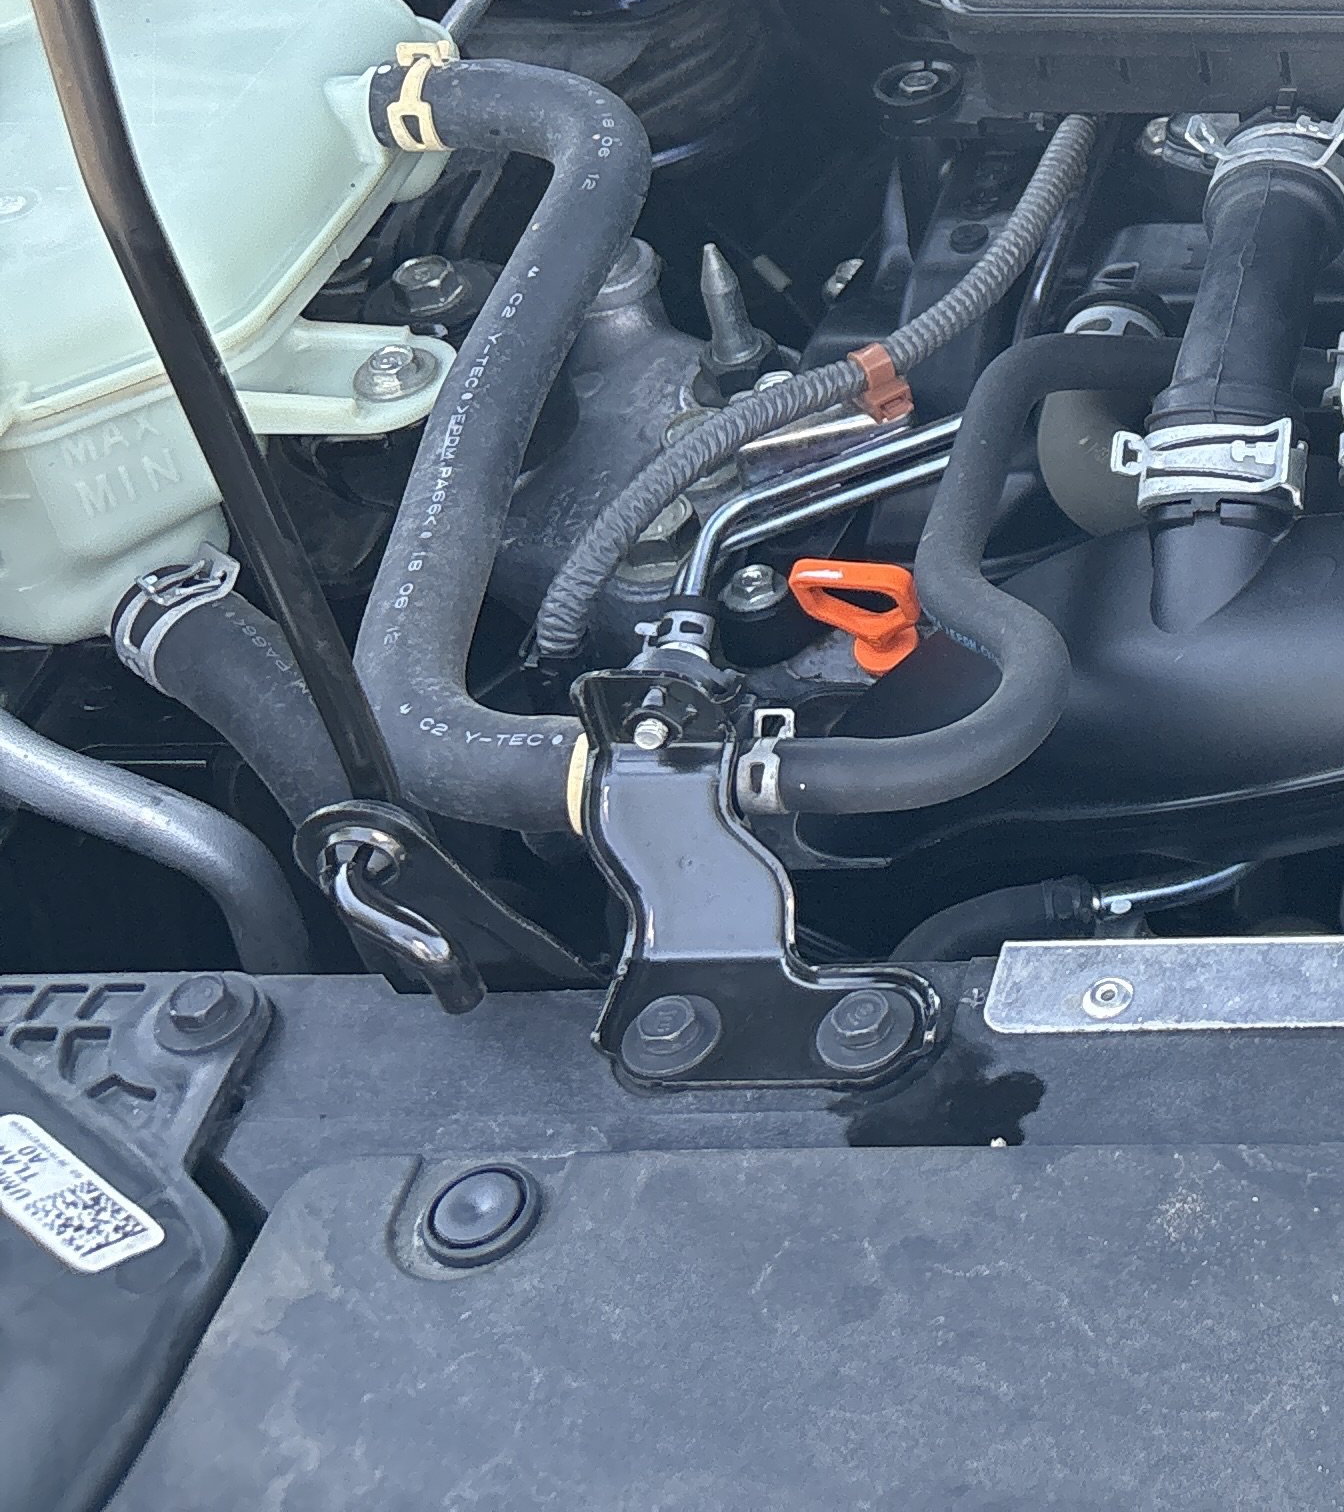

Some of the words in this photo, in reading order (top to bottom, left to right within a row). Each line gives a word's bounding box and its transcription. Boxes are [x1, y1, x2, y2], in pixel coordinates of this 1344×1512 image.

[600, 112, 616, 129] 18
[597, 136, 614, 159] 06
[580, 173, 601, 191] 12
[500, 291, 524, 320] C2
[463, 331, 503, 390] Y-TEC
[60, 411, 162, 468] MAX
[73, 446, 183, 519] MIN
[406, 551, 427, 573] 18
[393, 582, 414, 610] 06
[419, 716, 450, 738] C2
[465, 730, 546, 748] Y-TEC
